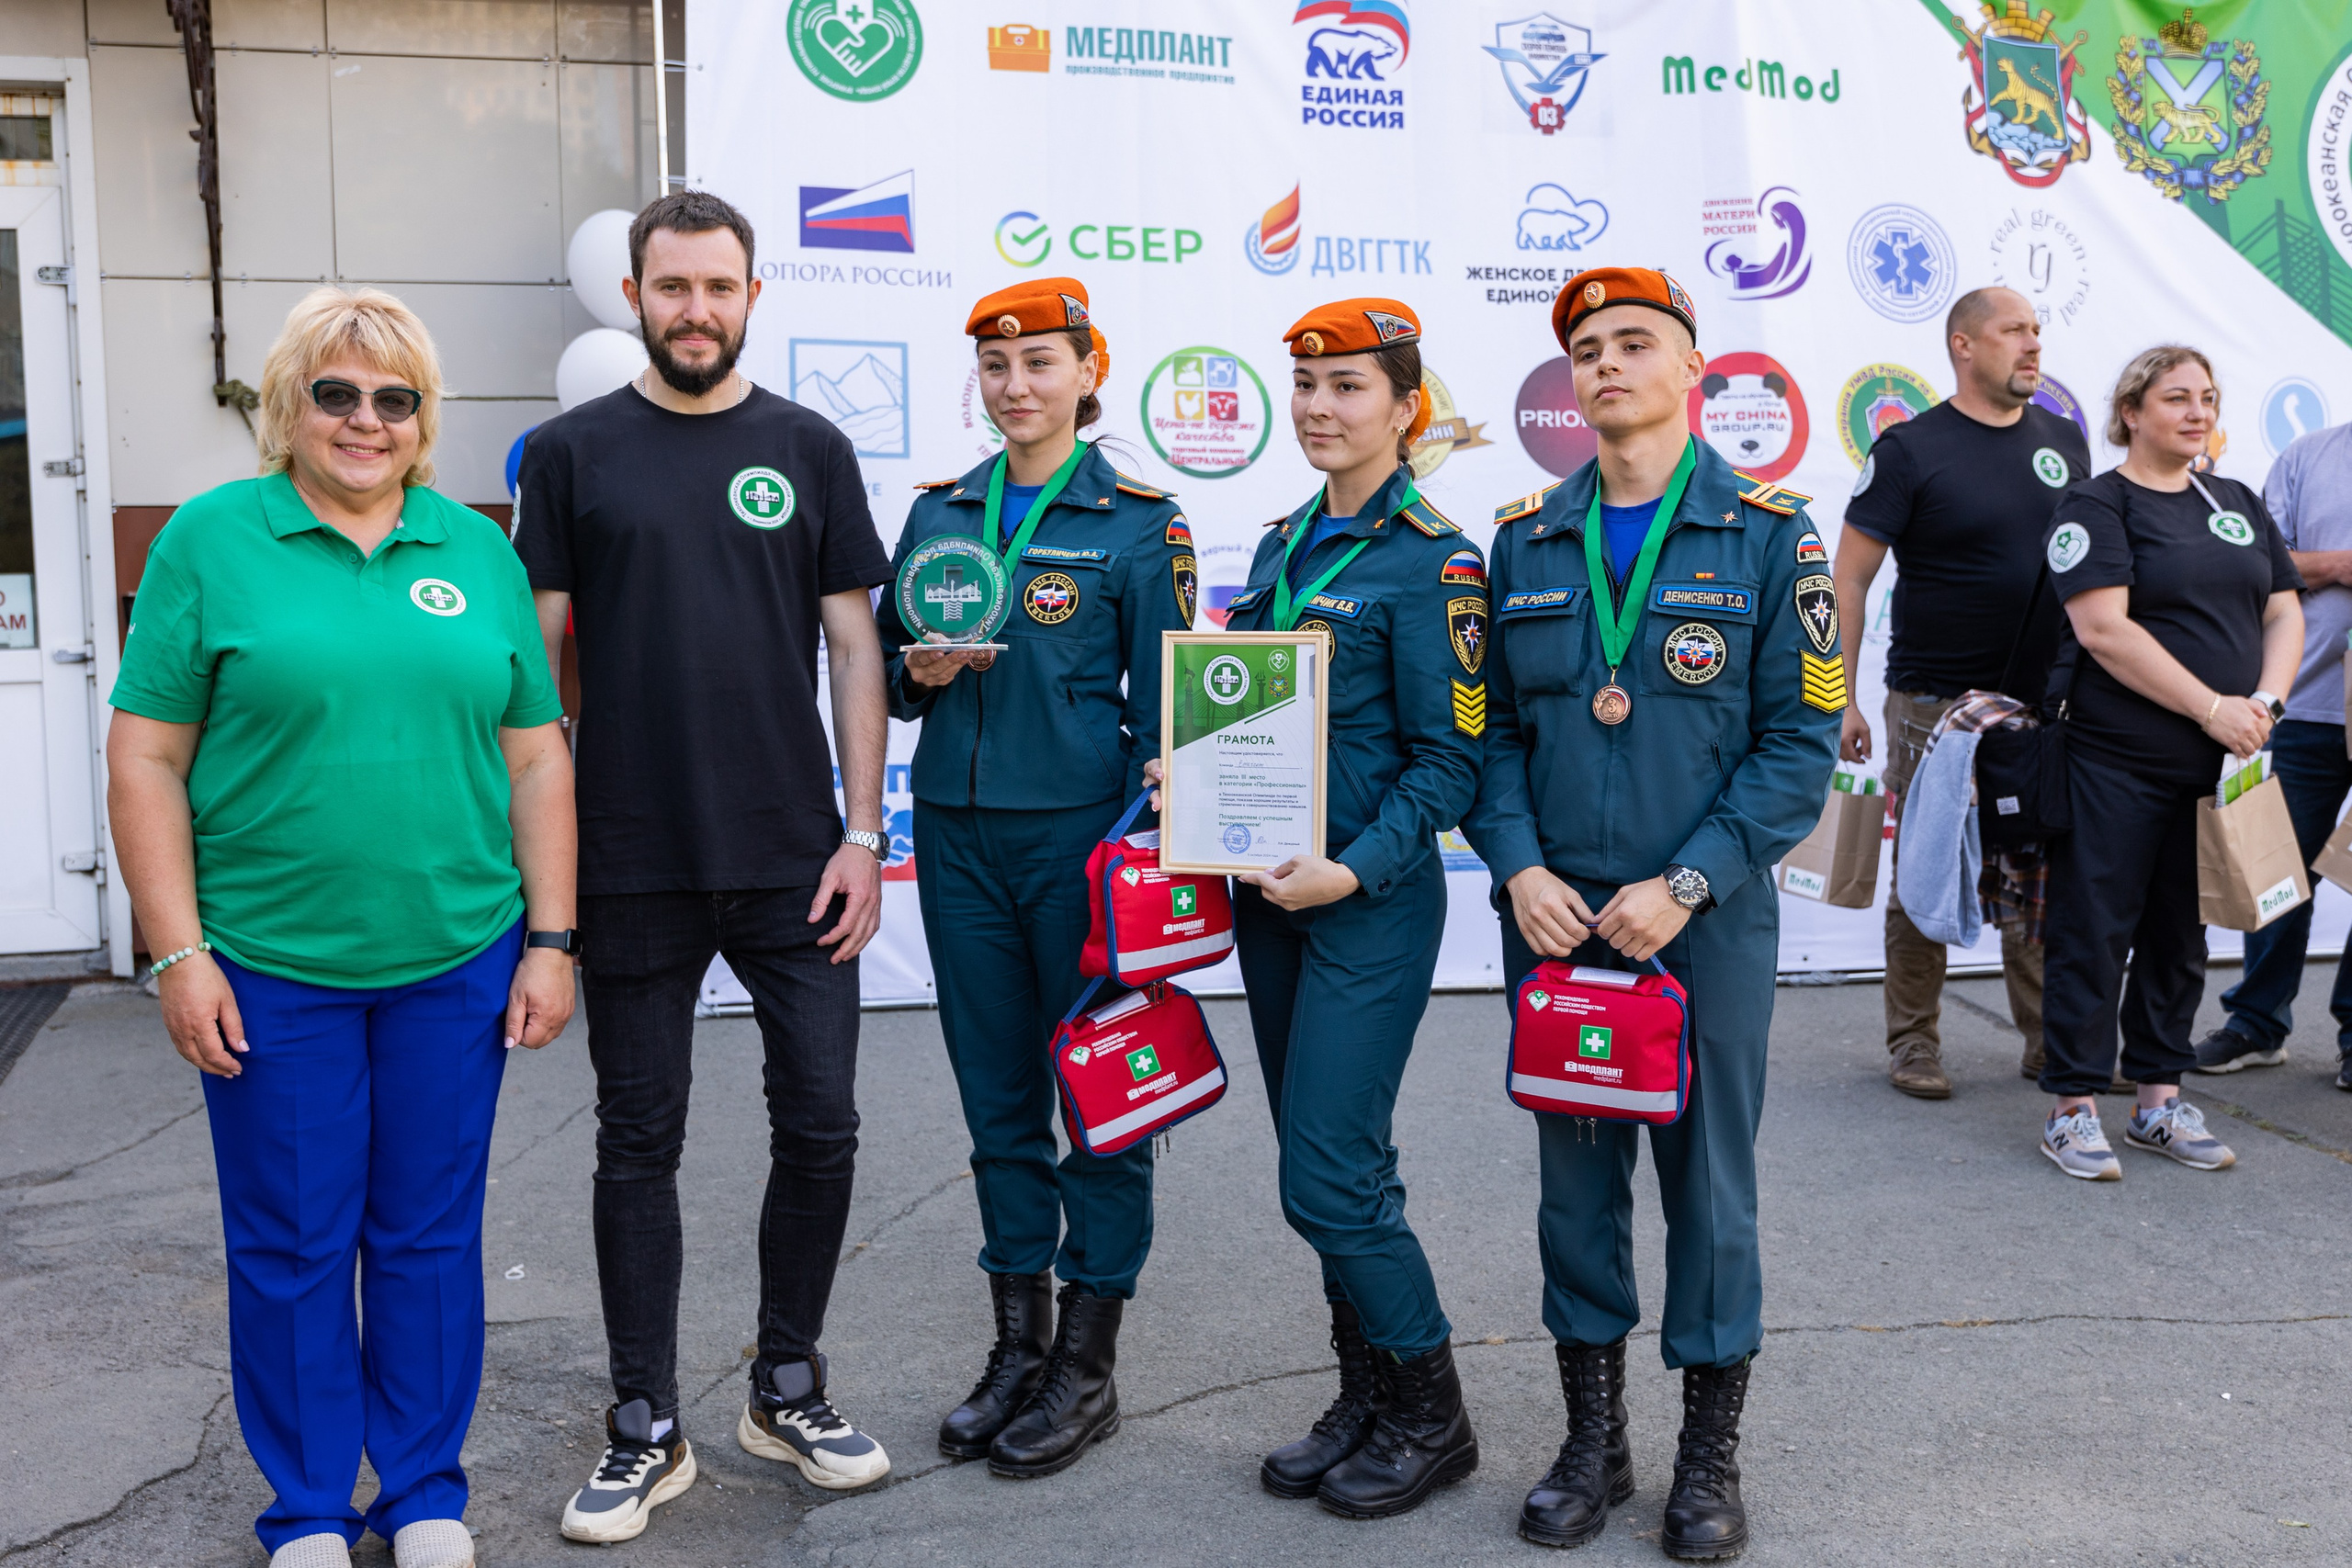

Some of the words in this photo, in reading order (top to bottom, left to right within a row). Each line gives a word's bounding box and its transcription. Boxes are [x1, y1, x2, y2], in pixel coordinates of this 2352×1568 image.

[1066, 26, 1233, 68] МЕДПЛАНТ
[1065, 64, 1167, 81] производственное
[1169, 68, 1237, 85] предприятие
[1661, 56, 1840, 104] MedMod
[1301, 85, 1405, 107] ЕДИНАЯ
[1301, 107, 1406, 130] РОССИЯ
[1537, 106, 1559, 127] 03
[2321, 89, 2352, 244] оокеанская
[1702, 210, 1756, 221] МАТЕРИ
[1702, 224, 1758, 236] РОССИИ
[1990, 208, 2023, 254] real
[2030, 209, 2086, 262] green
[1069, 223, 1204, 265] СБЕР
[1310, 236, 1432, 277] ДВГГТК
[760, 261, 846, 285] ОПОРА
[851, 265, 953, 289] РОССИИ
[1466, 266, 1557, 282] ЖЕНСКОЕ
[2059, 278, 2090, 327] real
[1849, 367, 1877, 389] УМВД
[1879, 366, 1917, 383] России
[1519, 409, 1588, 429] PRIO
[1706, 412, 1729, 422] MY
[1736, 411, 1788, 422] CHINA
[1711, 423, 1785, 434] GROUP.RU
[740, 470, 772, 480] Олимпиада
[1027, 547, 1080, 558] ГОРБУЛИЧЕВА
[1081, 550, 1100, 558] Ю.А.
[1030, 577, 1046, 592] МЧС
[1050, 575, 1076, 596] РОССИИ
[1453, 573, 1481, 584] RUSSIA
[1800, 580, 1815, 591] МЧС
[1336, 599, 1354, 614] В.В.
[1451, 601, 1467, 613] МЧС
[1506, 595, 1528, 608] МЧС
[1527, 591, 1568, 605] РОССИИ
[1663, 590, 1724, 605] ДЕНИСЕНКО
[1726, 593, 1746, 609] Т.О.
[1027, 602, 1071, 622] EMERCOM
[1668, 629, 1687, 649] МЧС
[1689, 626, 1724, 653] РОССИИ
[1669, 660, 1719, 682] EMERCOM
[1608, 697, 1617, 714] 3
[1216, 734, 1275, 745] ГРАМОТА
[1593, 1075, 1623, 1085] medplant.ru
